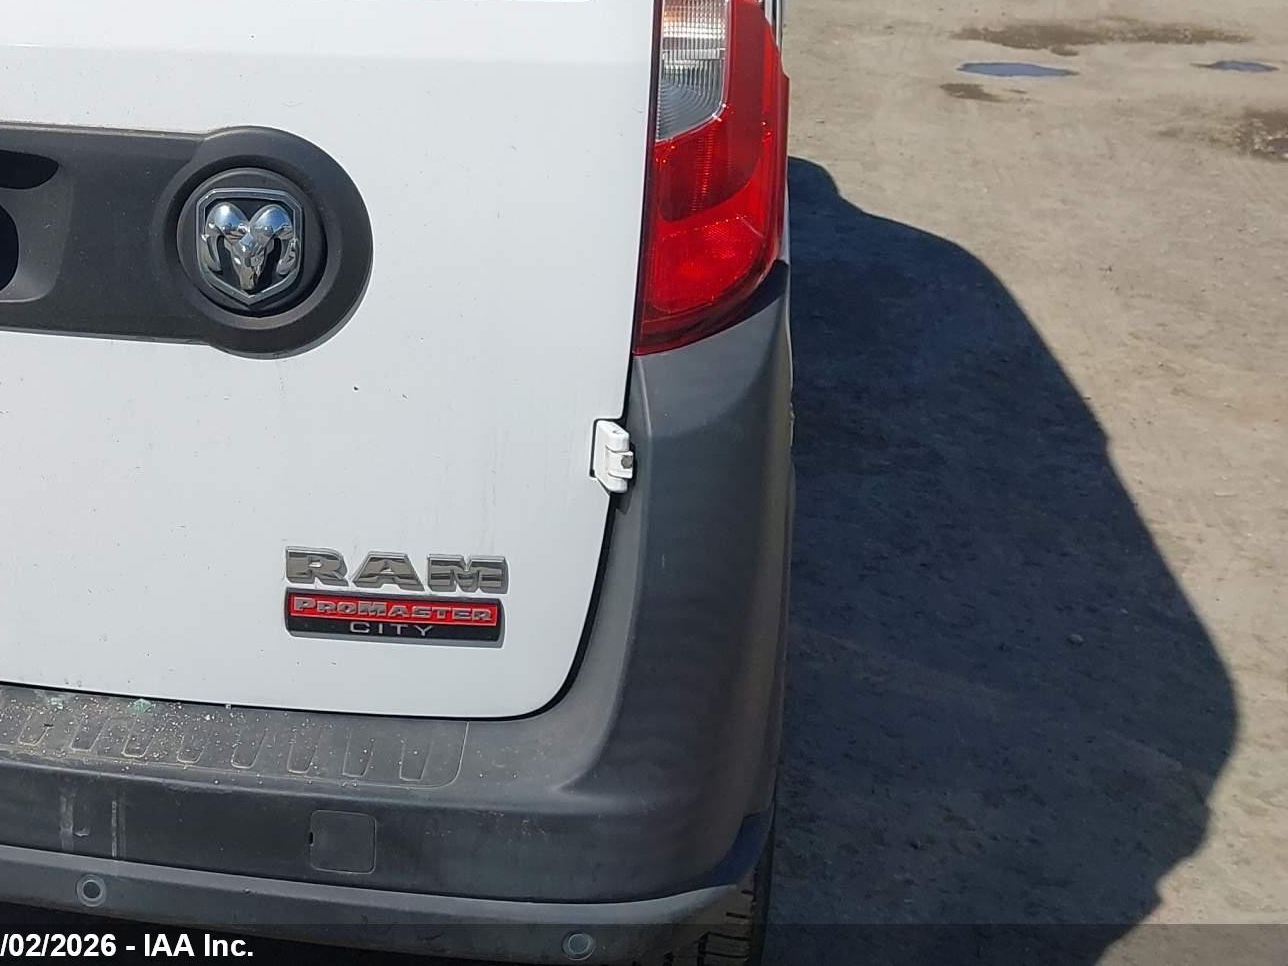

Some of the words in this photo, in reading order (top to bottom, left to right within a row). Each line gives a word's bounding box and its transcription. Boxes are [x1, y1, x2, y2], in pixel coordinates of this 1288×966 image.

[285, 546, 509, 594] RAM
[293, 597, 493, 622] PROMASTER
[349, 622, 434, 637] CITY
